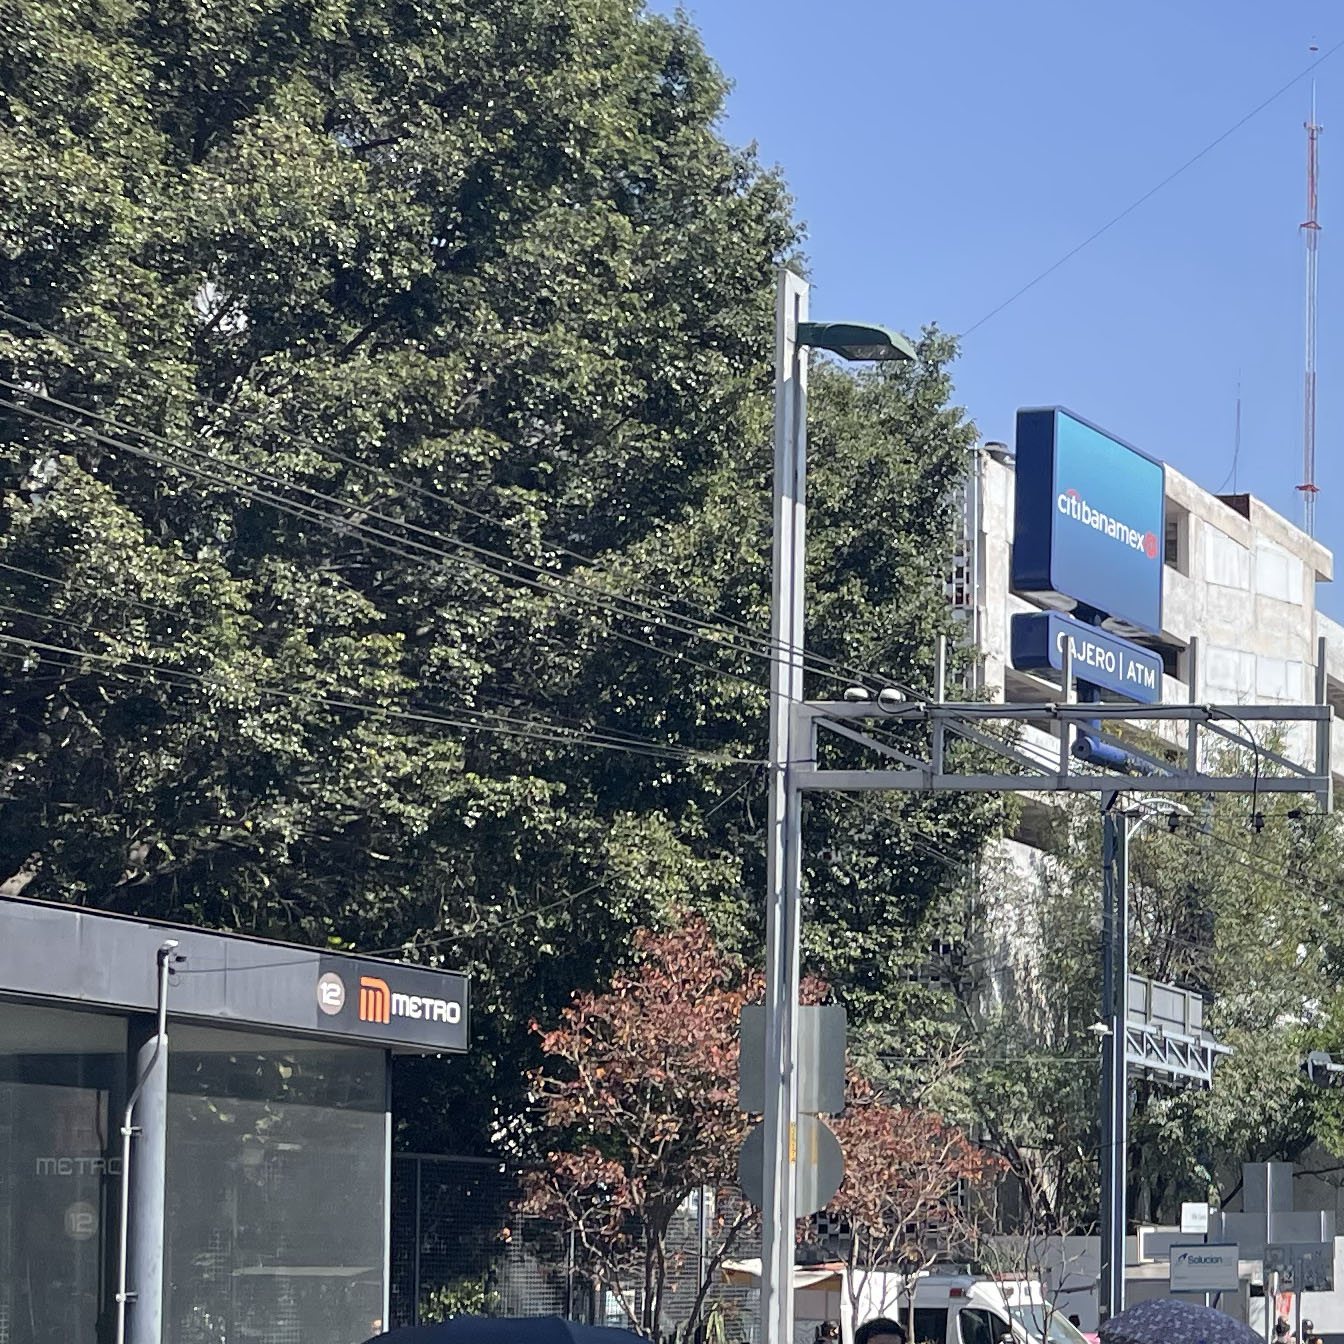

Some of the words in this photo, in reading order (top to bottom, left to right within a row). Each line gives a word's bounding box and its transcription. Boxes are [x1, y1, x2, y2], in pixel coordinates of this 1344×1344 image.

[1058, 491, 1145, 552] citibanamex
[1127, 662, 1155, 689] ATM
[320, 983, 341, 1006] 12
[392, 993, 461, 1024] METRO
[70, 1213, 92, 1232] 12
